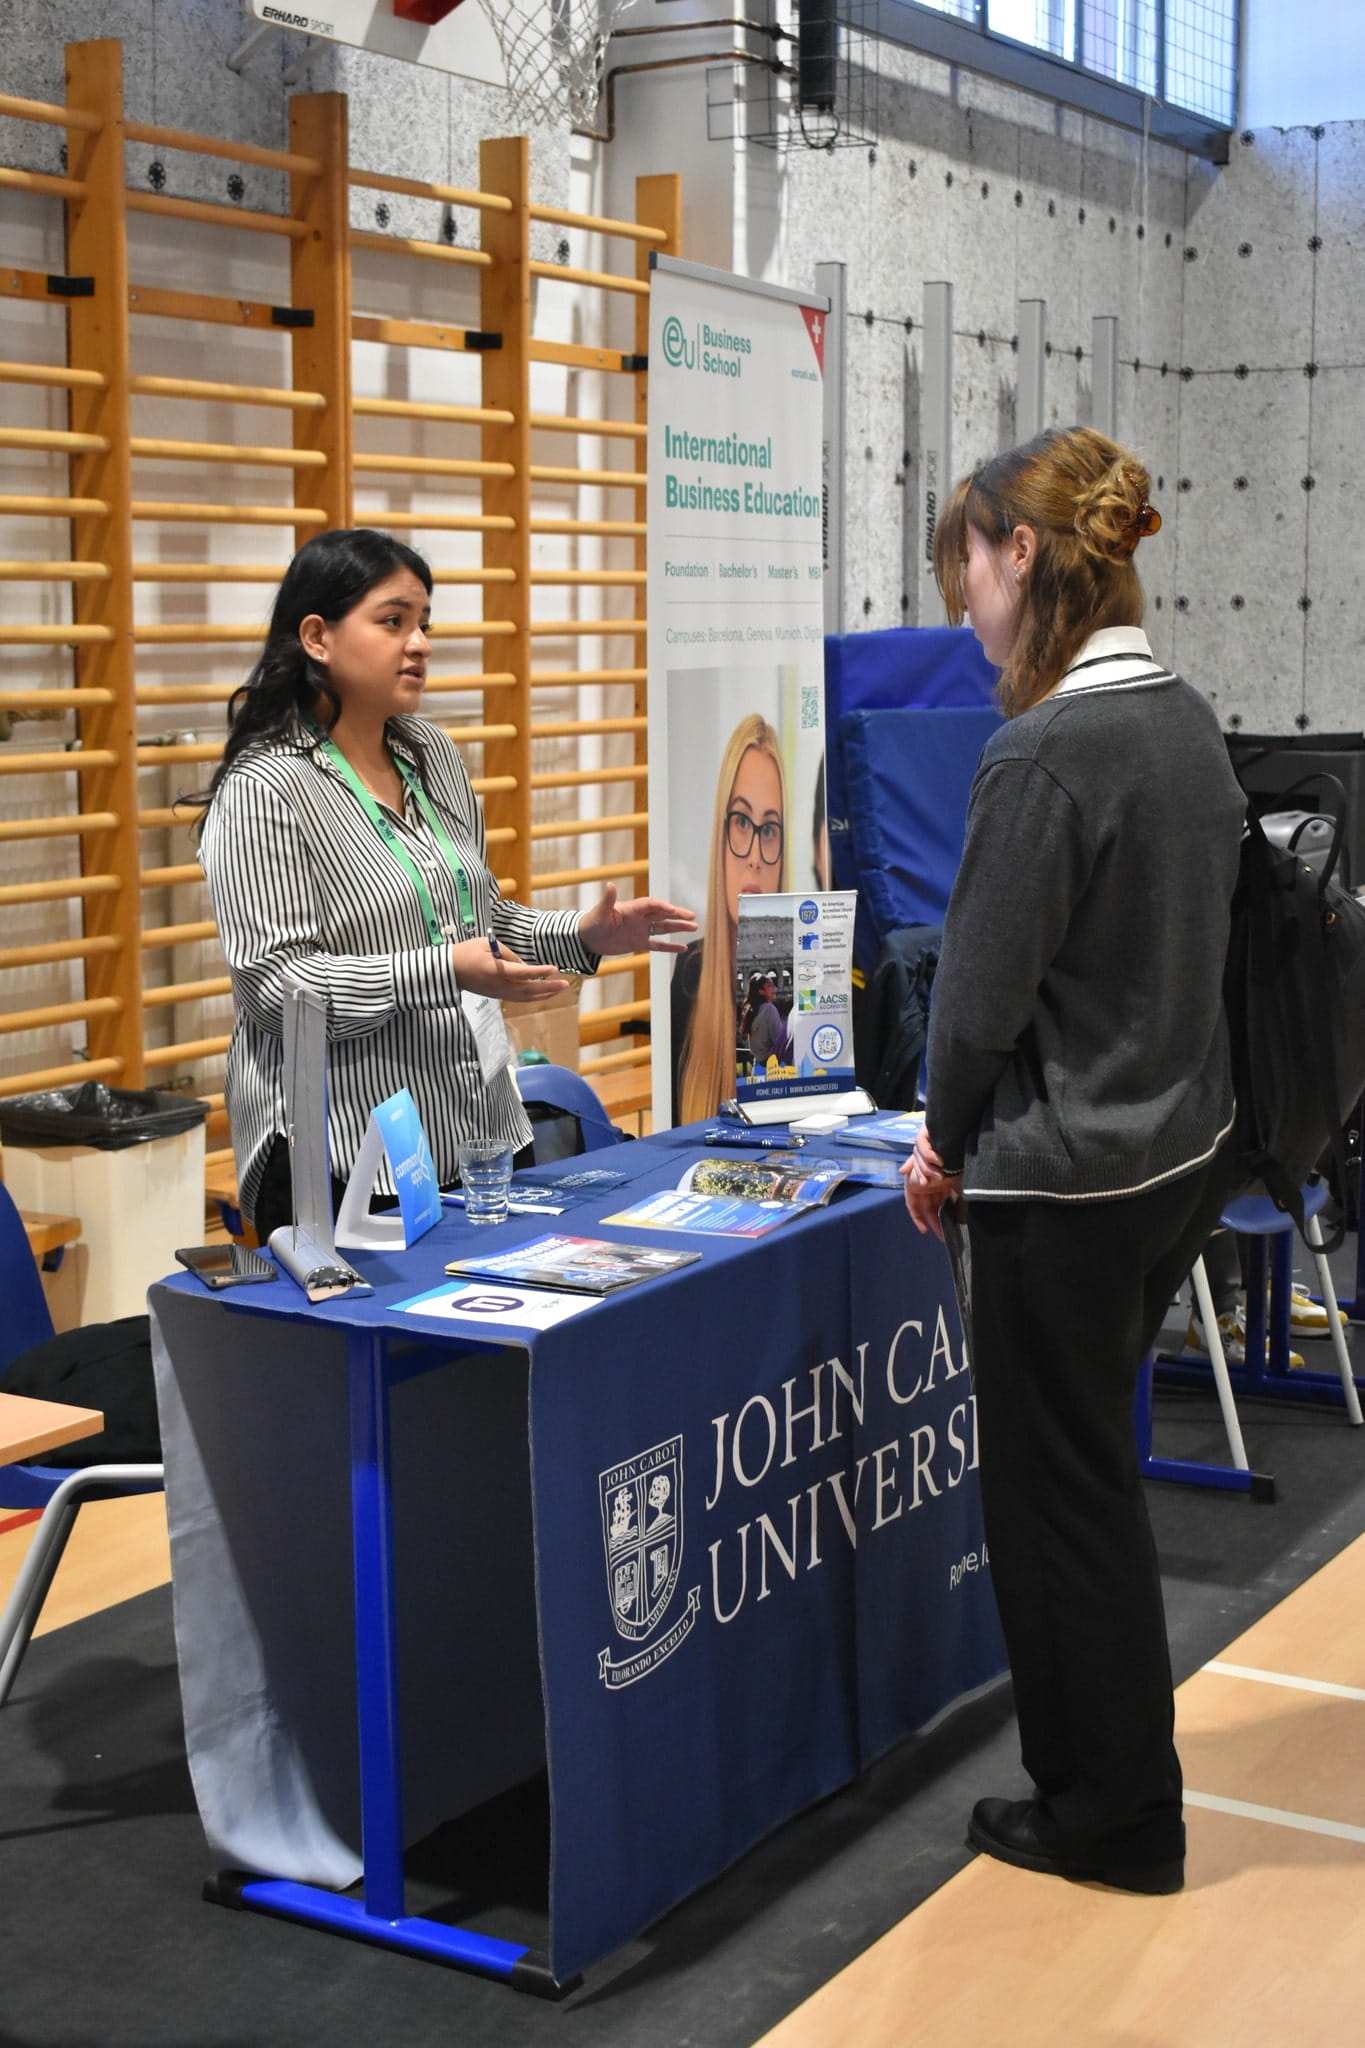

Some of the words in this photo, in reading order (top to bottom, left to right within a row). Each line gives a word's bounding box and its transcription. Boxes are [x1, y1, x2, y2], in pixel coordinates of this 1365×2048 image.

[262, 6, 309, 28] ERHARD
[703, 324, 751, 354] Business
[703, 352, 741, 378] School
[665, 425, 772, 469] International
[665, 474, 740, 513] Business
[744, 482, 820, 518] Education
[665, 561, 709, 577] Foundation
[719, 563, 758, 579] Bachelor's
[768, 564, 799, 580] Master's
[819, 993, 848, 1004] AACSB
[706, 1341, 870, 1511] JOHN
[886, 1304, 969, 1404] CA
[606, 1462, 637, 1489] JOHN
[639, 1441, 678, 1472] CABOT
[653, 1618, 690, 1661] EXCELLO
